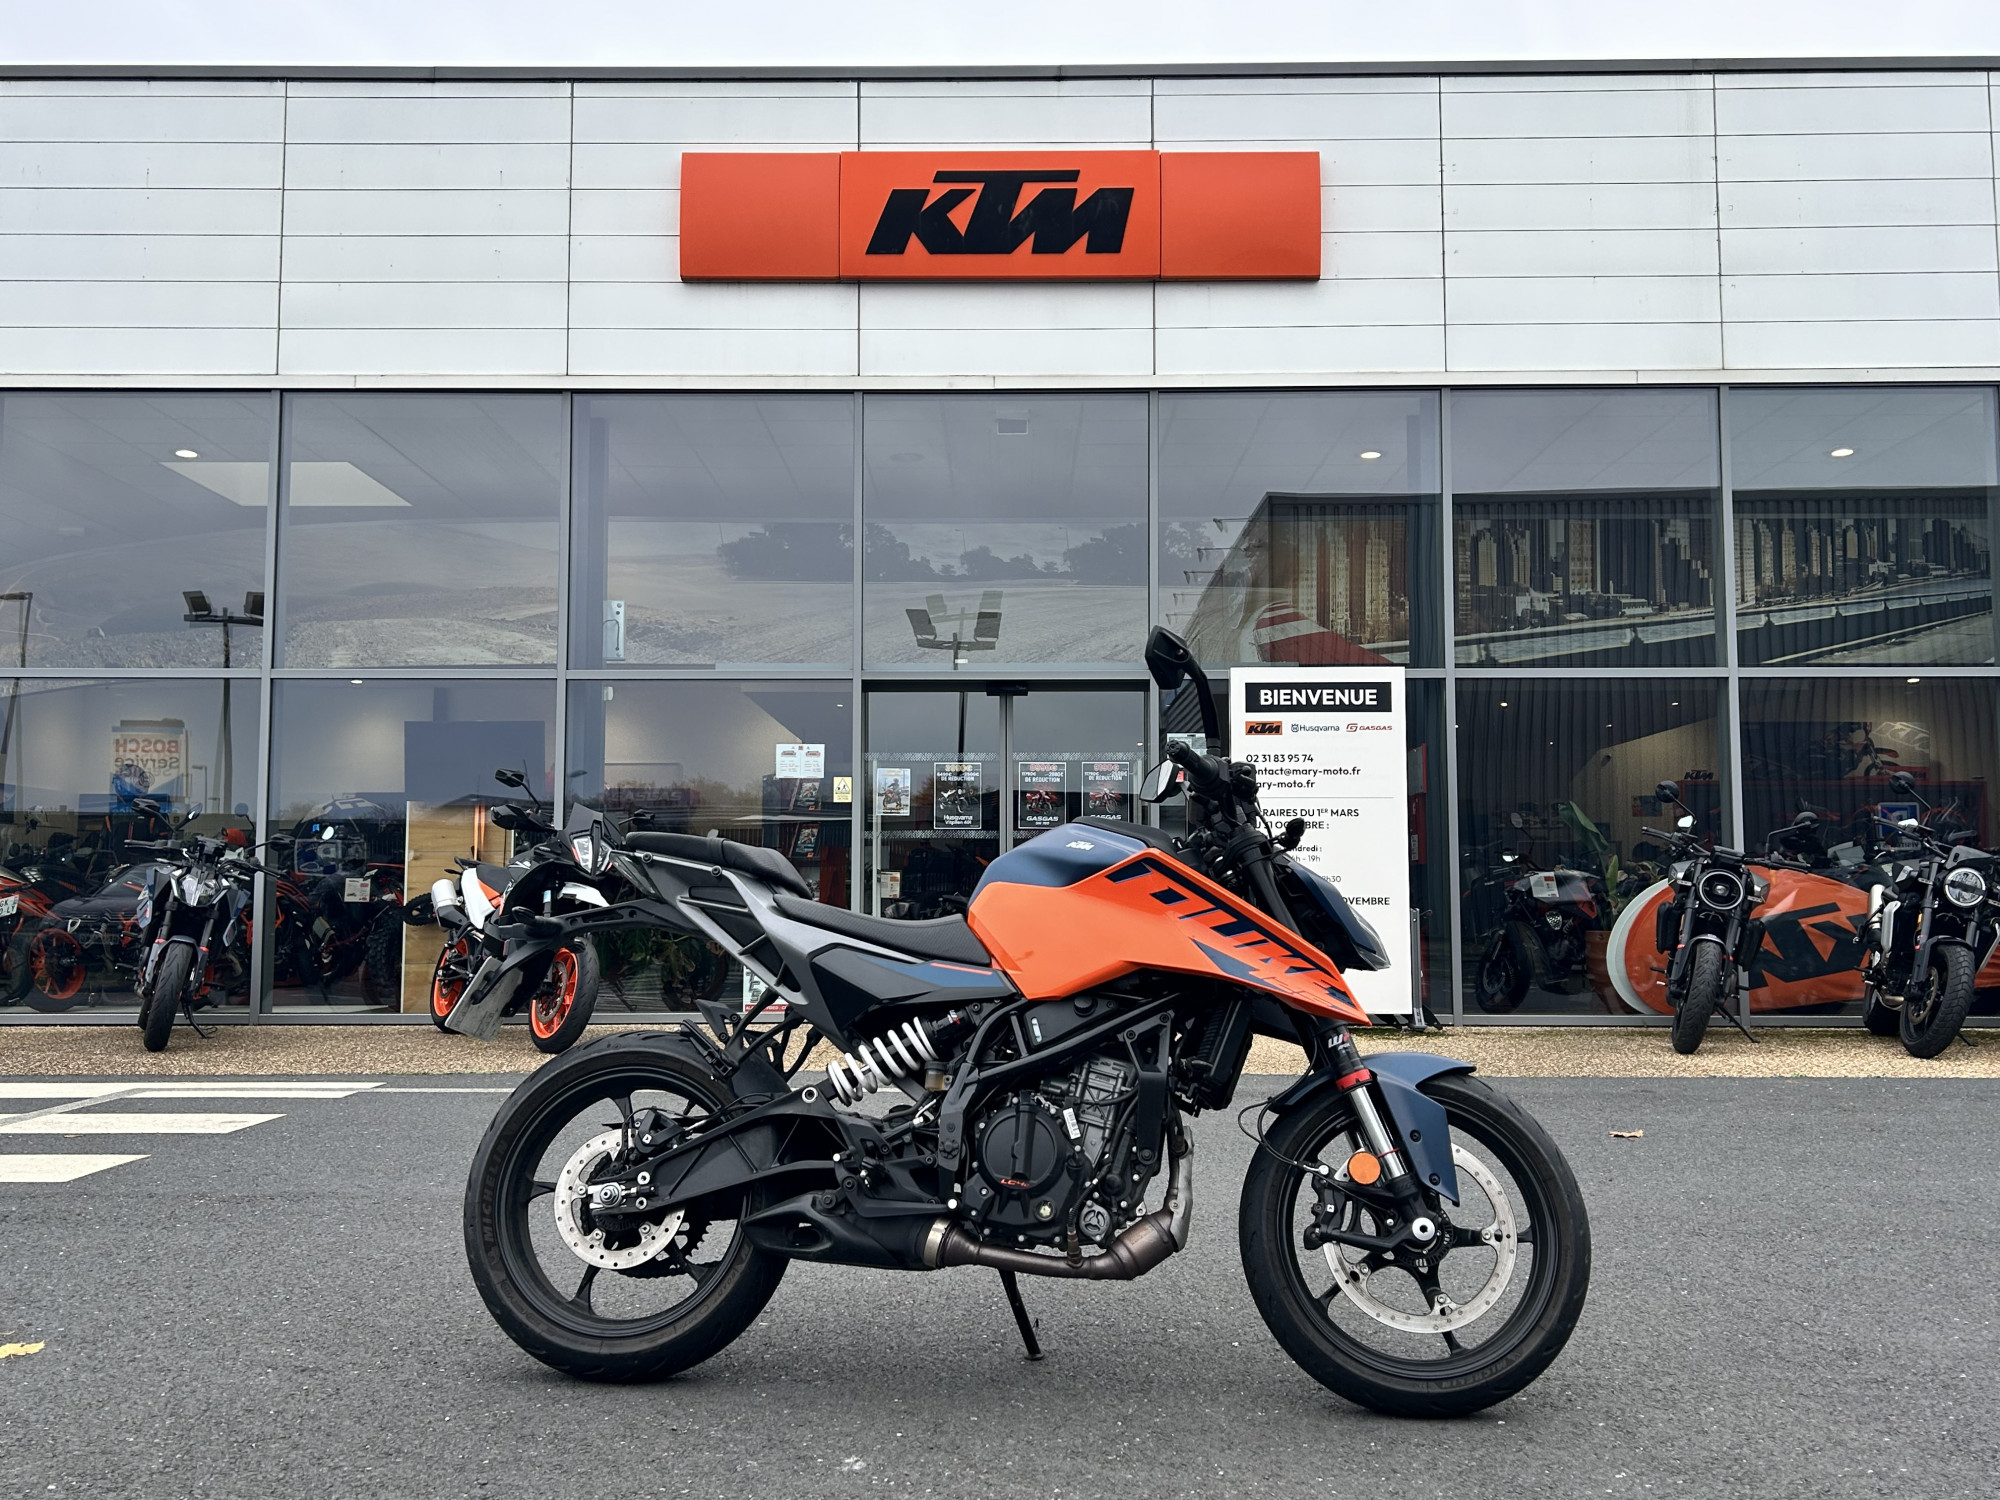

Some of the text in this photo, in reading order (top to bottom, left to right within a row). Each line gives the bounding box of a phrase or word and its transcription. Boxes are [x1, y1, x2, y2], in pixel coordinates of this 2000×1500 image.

[865, 169, 1134, 255] KTM
[1259, 688, 1378, 706] BIENVENUE
[1247, 722, 1281, 734] KTM
[1299, 724, 1340, 733] Husqvarna
[1246, 754, 1314, 763] 02 31 83 95 74
[1256, 767, 1361, 776] ntact@mary-moto.fr
[1684, 769, 1714, 780] KTM
[1256, 779, 1315, 790] ary-moto.fr
[1260, 808, 1298, 817] RAIRES
[1299, 808, 1318, 817] DU
[1330, 808, 1360, 817] MARS
[1065, 840, 1095, 851] KTM
[1341, 896, 1391, 906] OVEMBRE
[482, 1141, 508, 1243] MICHELIN
[1441, 1357, 1509, 1389] MICHELIN
